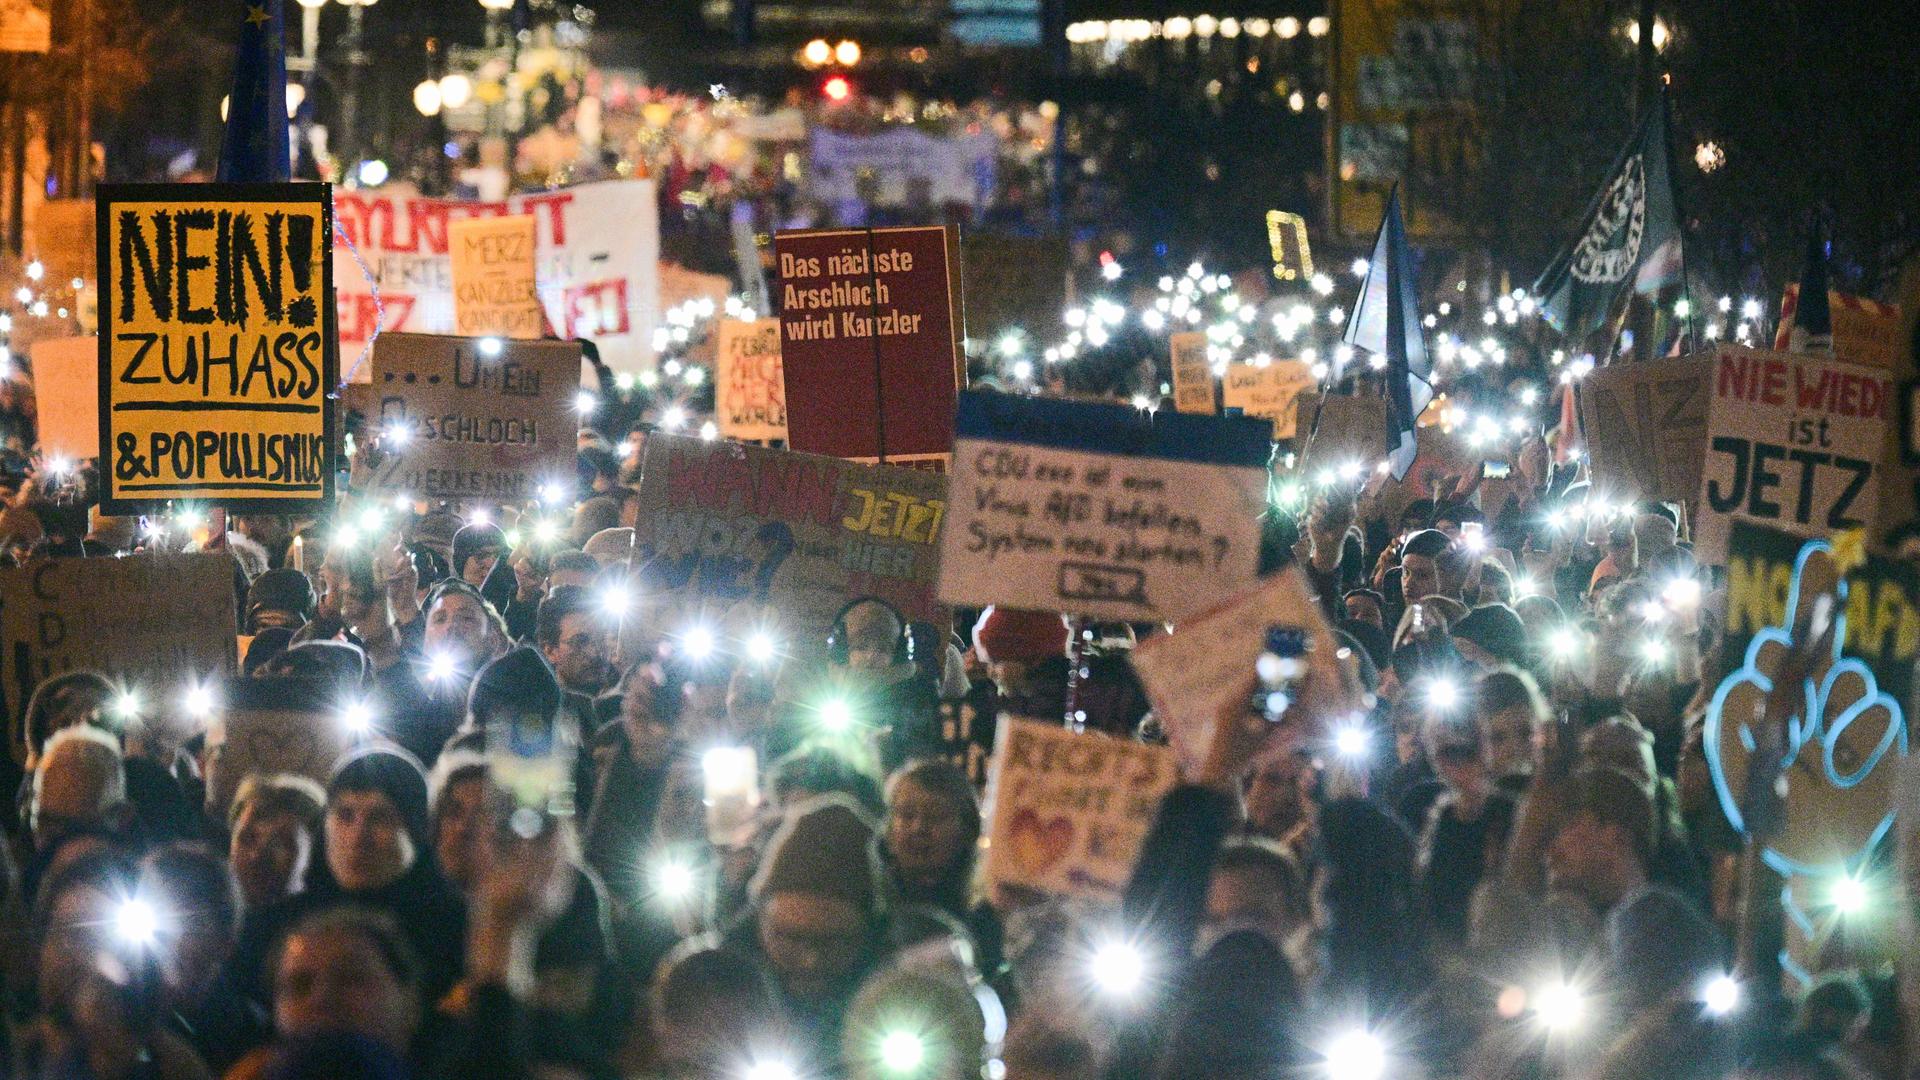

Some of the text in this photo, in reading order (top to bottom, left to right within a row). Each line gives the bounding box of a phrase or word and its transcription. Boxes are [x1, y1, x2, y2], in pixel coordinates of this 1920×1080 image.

[118, 208, 318, 331] NEIN!
[781, 248, 913, 279] Das nächste
[784, 278, 890, 310] Arschloch
[786, 309, 922, 341] wird Kanzler
[1718, 354, 1788, 406] NIE
[1789, 412, 1832, 448] ist
[150, 431, 324, 483] POPULISMUS
[842, 488, 946, 545] JETZT
